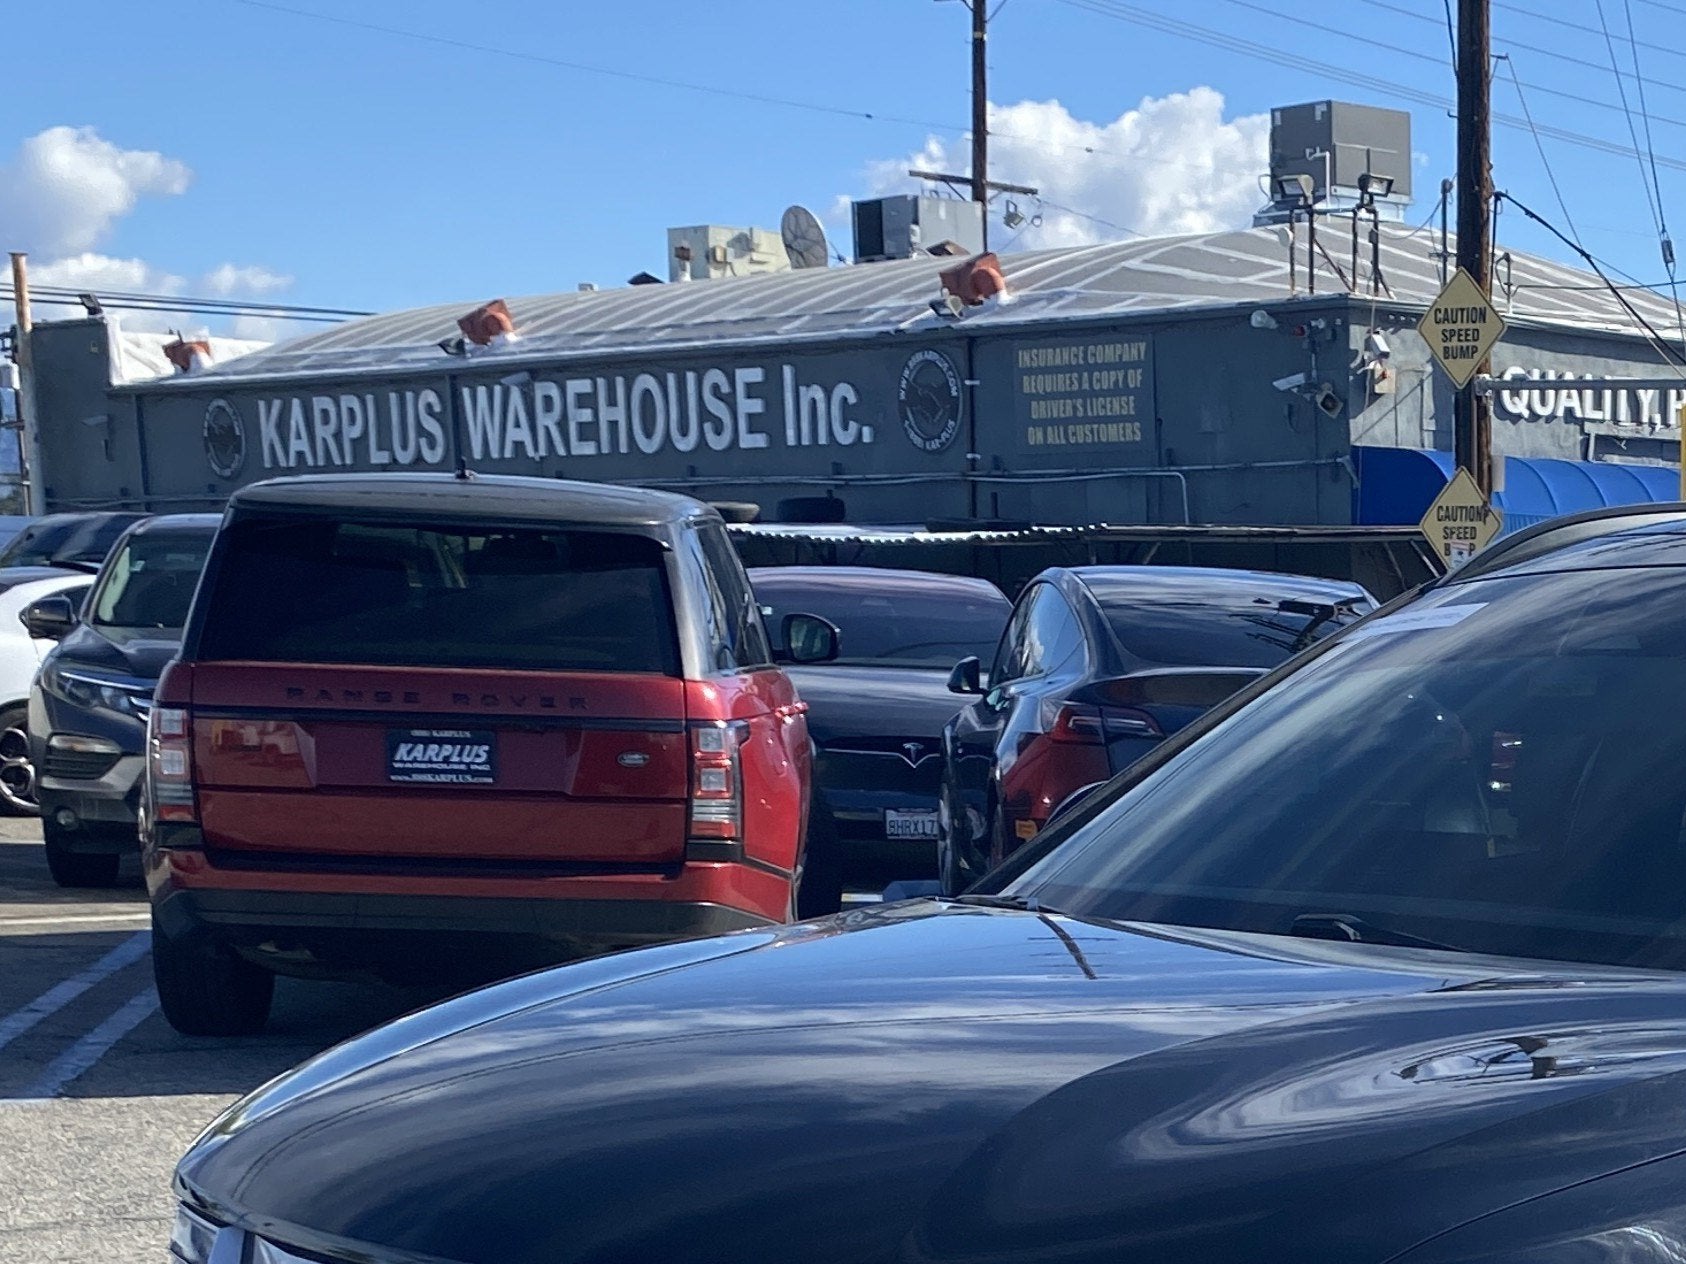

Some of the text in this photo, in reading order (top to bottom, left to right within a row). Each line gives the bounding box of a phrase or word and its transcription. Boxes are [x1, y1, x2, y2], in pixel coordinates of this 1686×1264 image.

[1434, 307, 1487, 324] CAUTION
[1441, 328, 1480, 343] SPEED
[1019, 342, 1146, 368] INSURANCE COMPANY
[1443, 346, 1478, 359] BUMP
[1023, 368, 1143, 395] REQUIRES A COPY OF
[1031, 396, 1135, 419] DRIVER'S LICENSE
[1501, 366, 1661, 432] QUALITY,
[258, 388, 446, 468] KARPLUS
[462, 367, 770, 462] WAREHOUSE
[782, 364, 874, 446] Inc.
[1028, 422, 1141, 445] ON ALL CUSTOMERS
[1437, 506, 1484, 522] CAUTION
[1443, 526, 1477, 540] SPEED
[1444, 542, 1476, 556] BP
[287, 687, 589, 710] RANGE ROVER
[394, 742, 491, 763] KARPLUS
